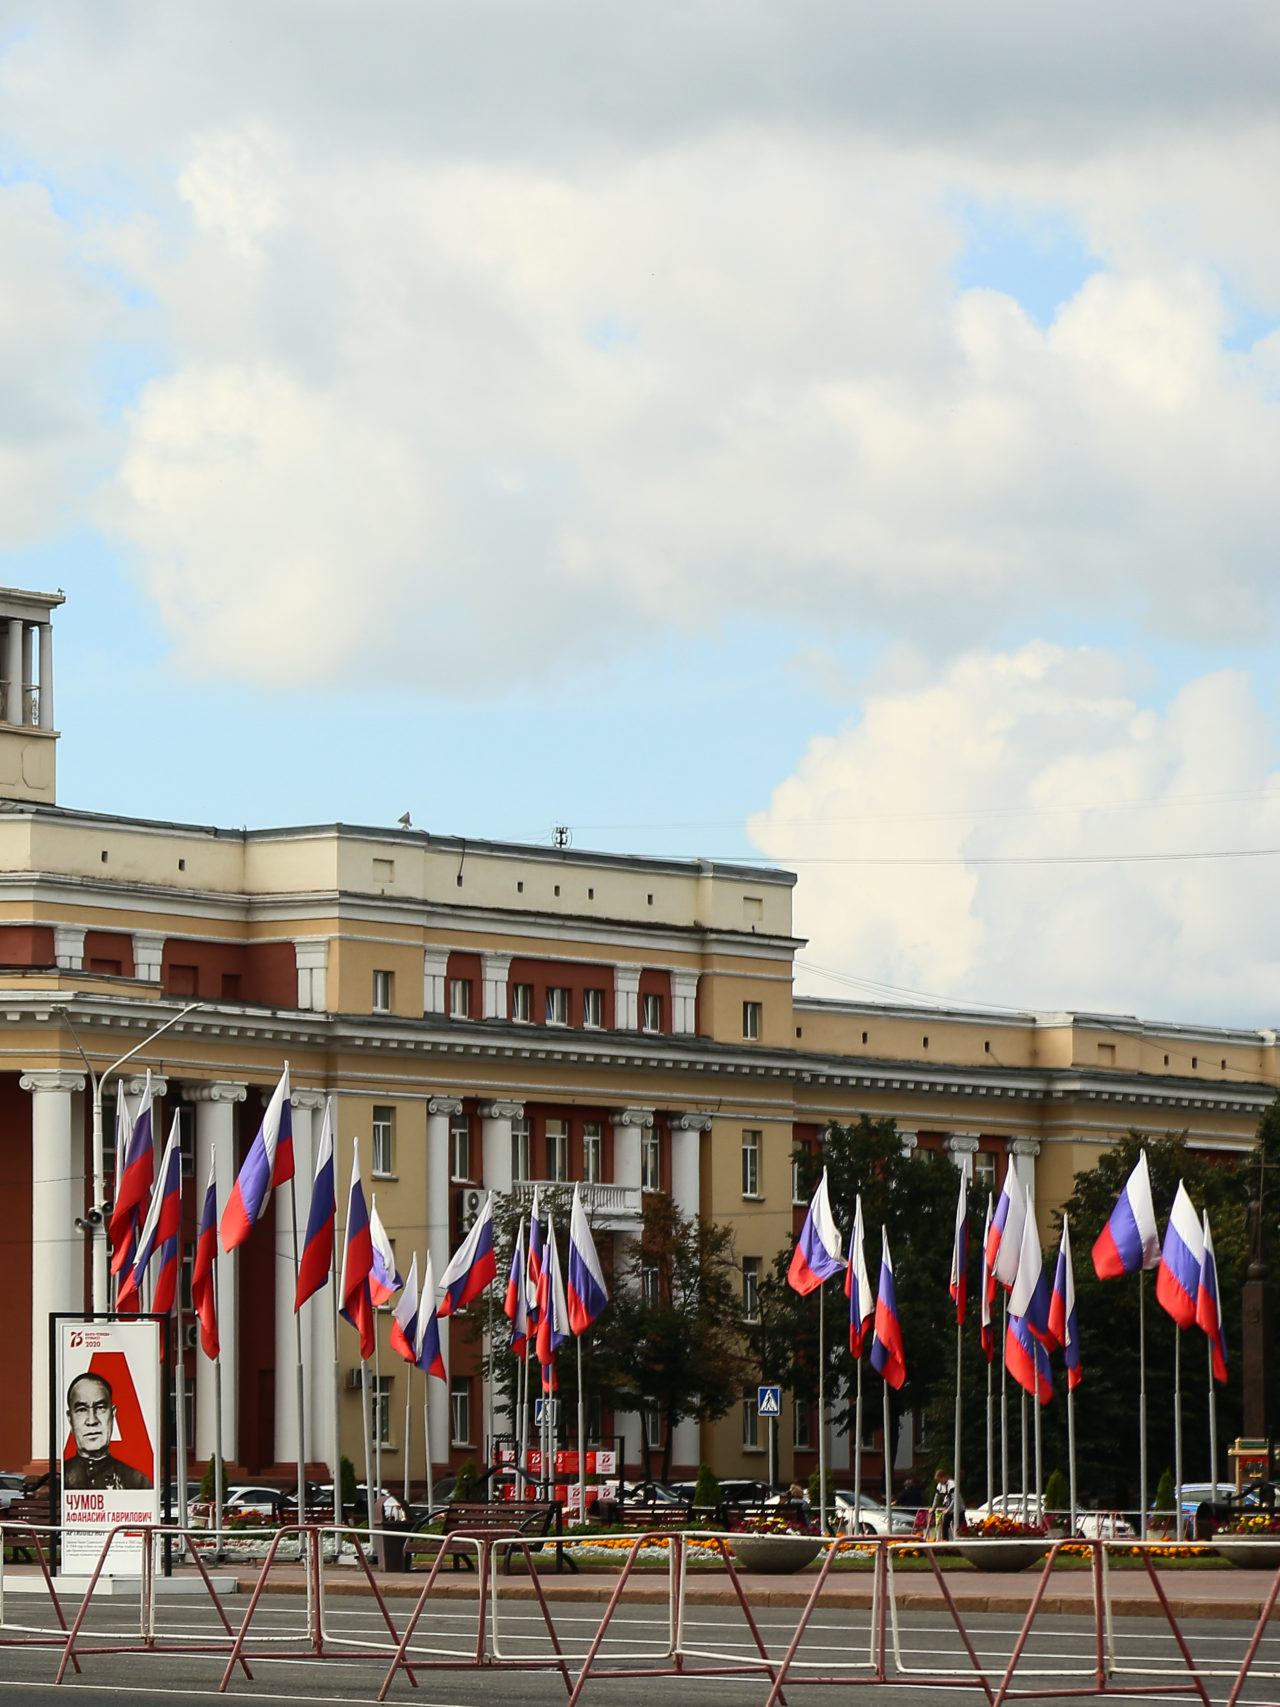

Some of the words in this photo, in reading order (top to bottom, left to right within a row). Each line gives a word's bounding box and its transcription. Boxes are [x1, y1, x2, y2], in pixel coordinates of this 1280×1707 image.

[70, 1331, 83, 1348] 75
[66, 1494, 104, 1510] ЧУМОВ
[66, 1510, 105, 1522] АФАНАСИЙ
[107, 1511, 152, 1522] ГАВРИЛОВИЧ
